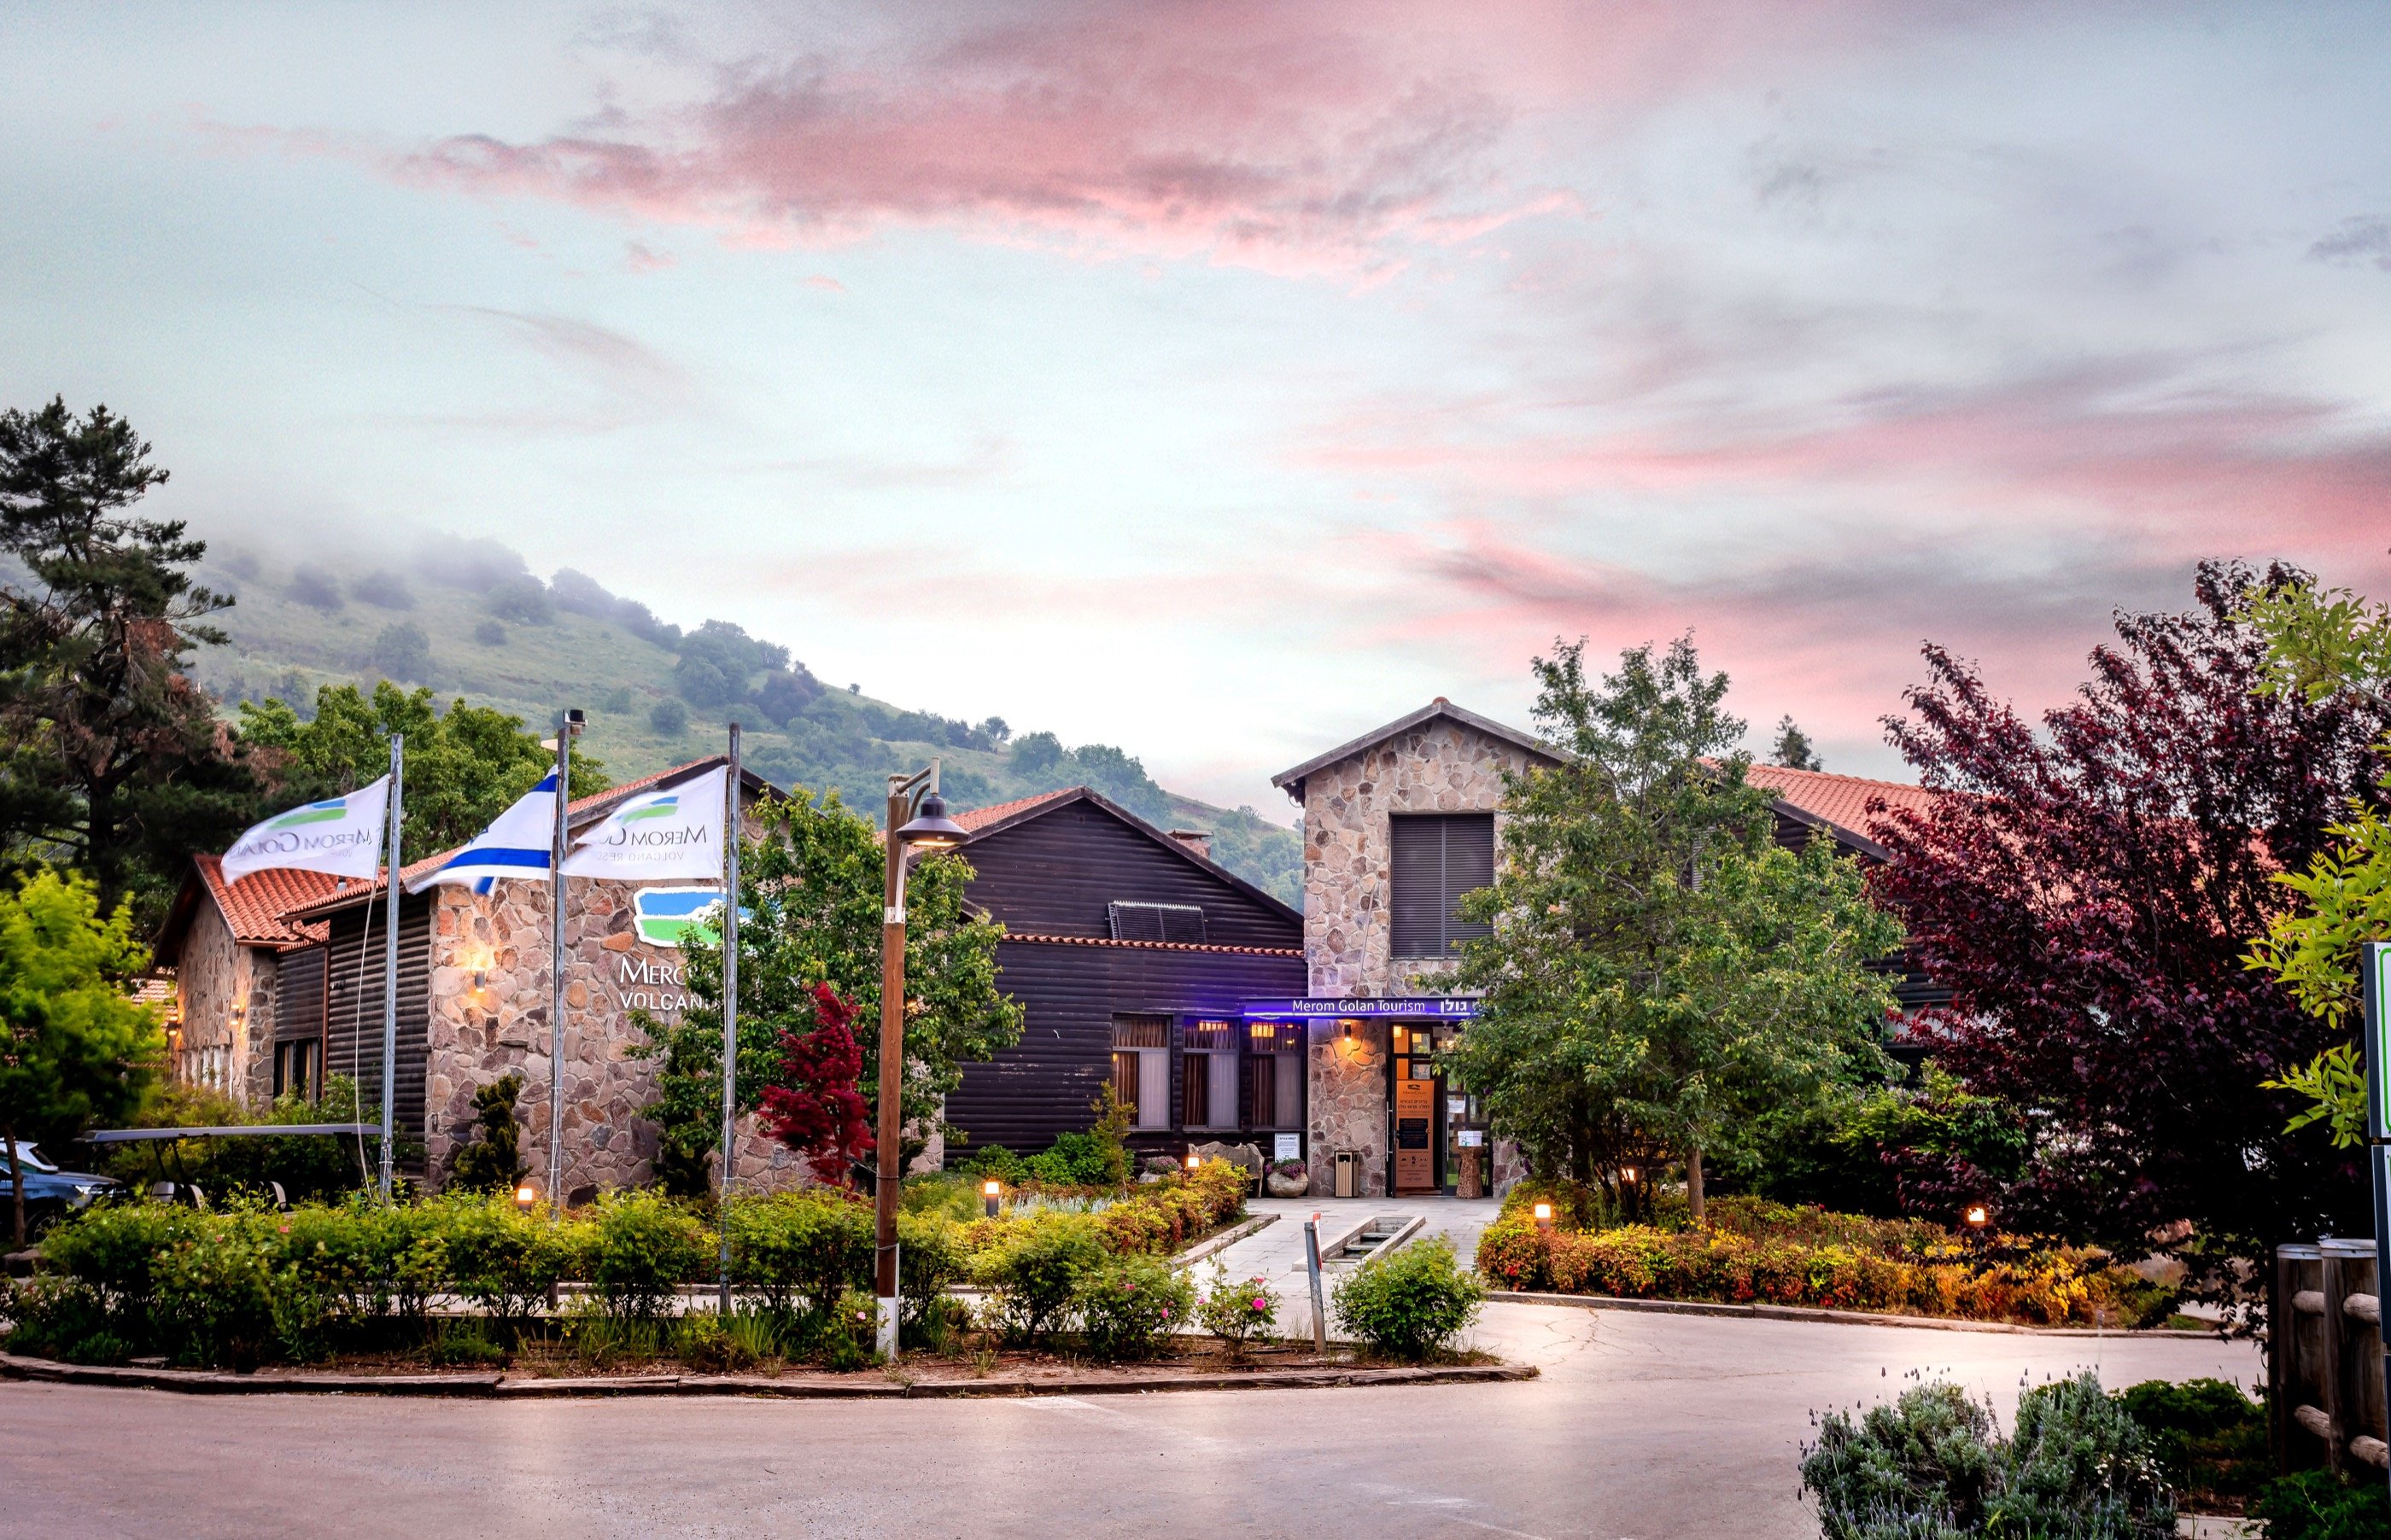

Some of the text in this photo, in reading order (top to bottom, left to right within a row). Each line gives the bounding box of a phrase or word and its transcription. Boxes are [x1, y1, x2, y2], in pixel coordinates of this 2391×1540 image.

[620, 992, 709, 1010] VOLCAN
[1292, 1000, 1425, 1012] Merom Golan Tourism
[1440, 998, 1467, 1014] גולן
